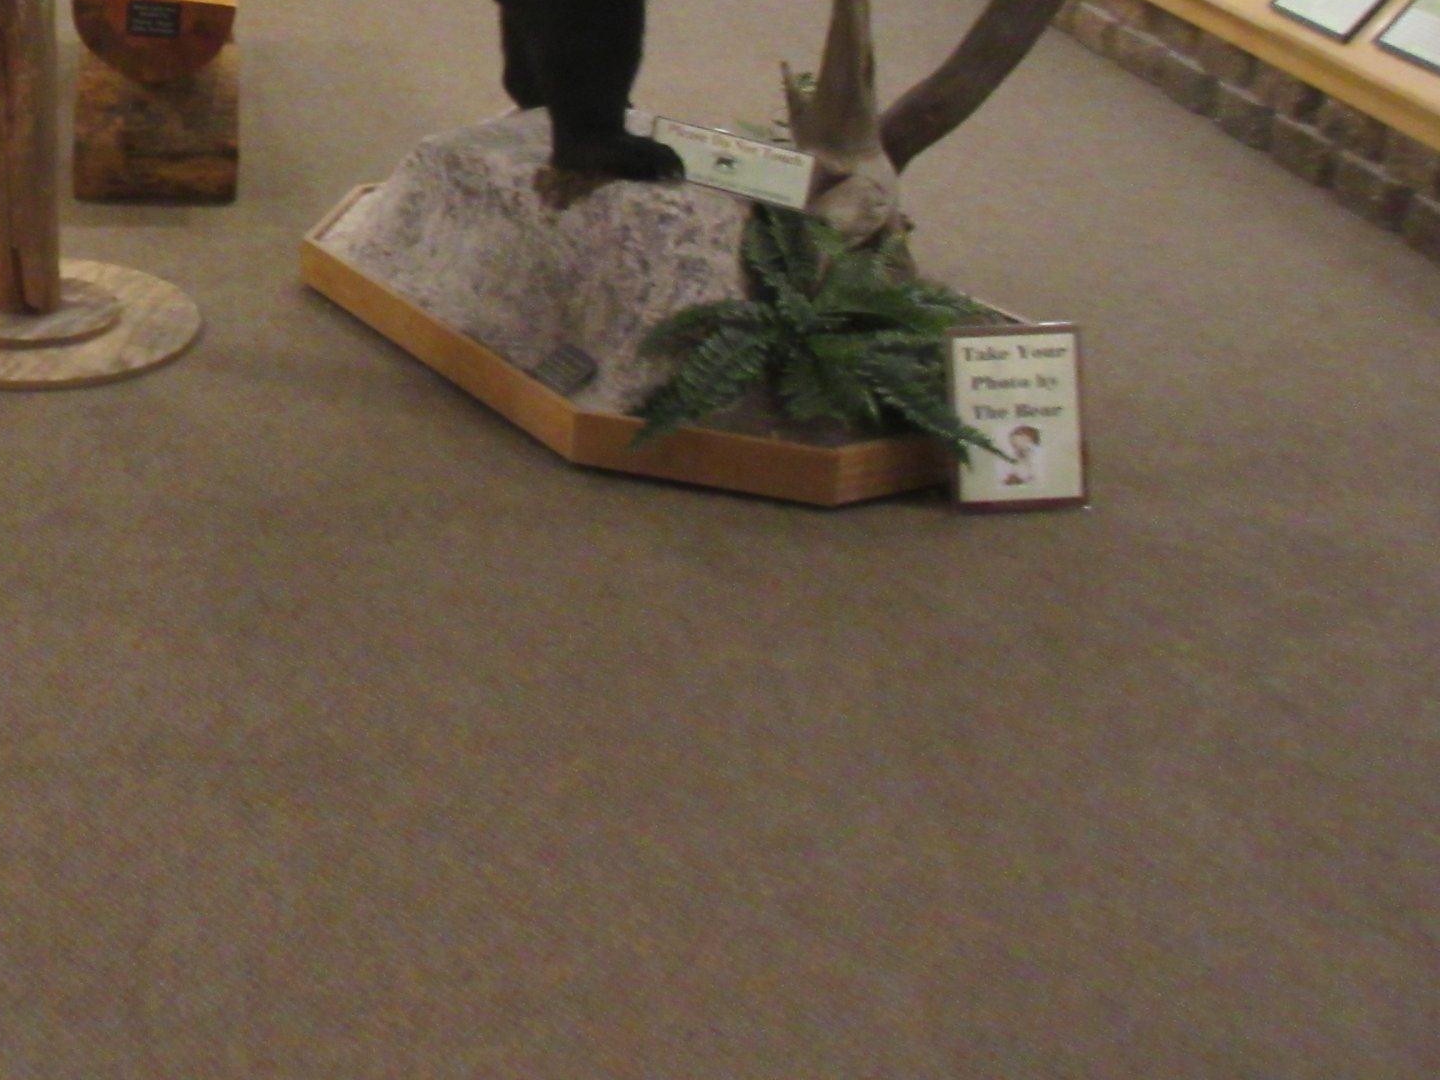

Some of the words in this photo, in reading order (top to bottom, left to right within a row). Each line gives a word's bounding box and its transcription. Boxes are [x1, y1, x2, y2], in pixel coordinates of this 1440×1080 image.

[962, 346, 1010, 362] Take
[1016, 344, 1068, 359] Your
[973, 404, 1009, 420] The
[1014, 403, 1063, 418] Bear
